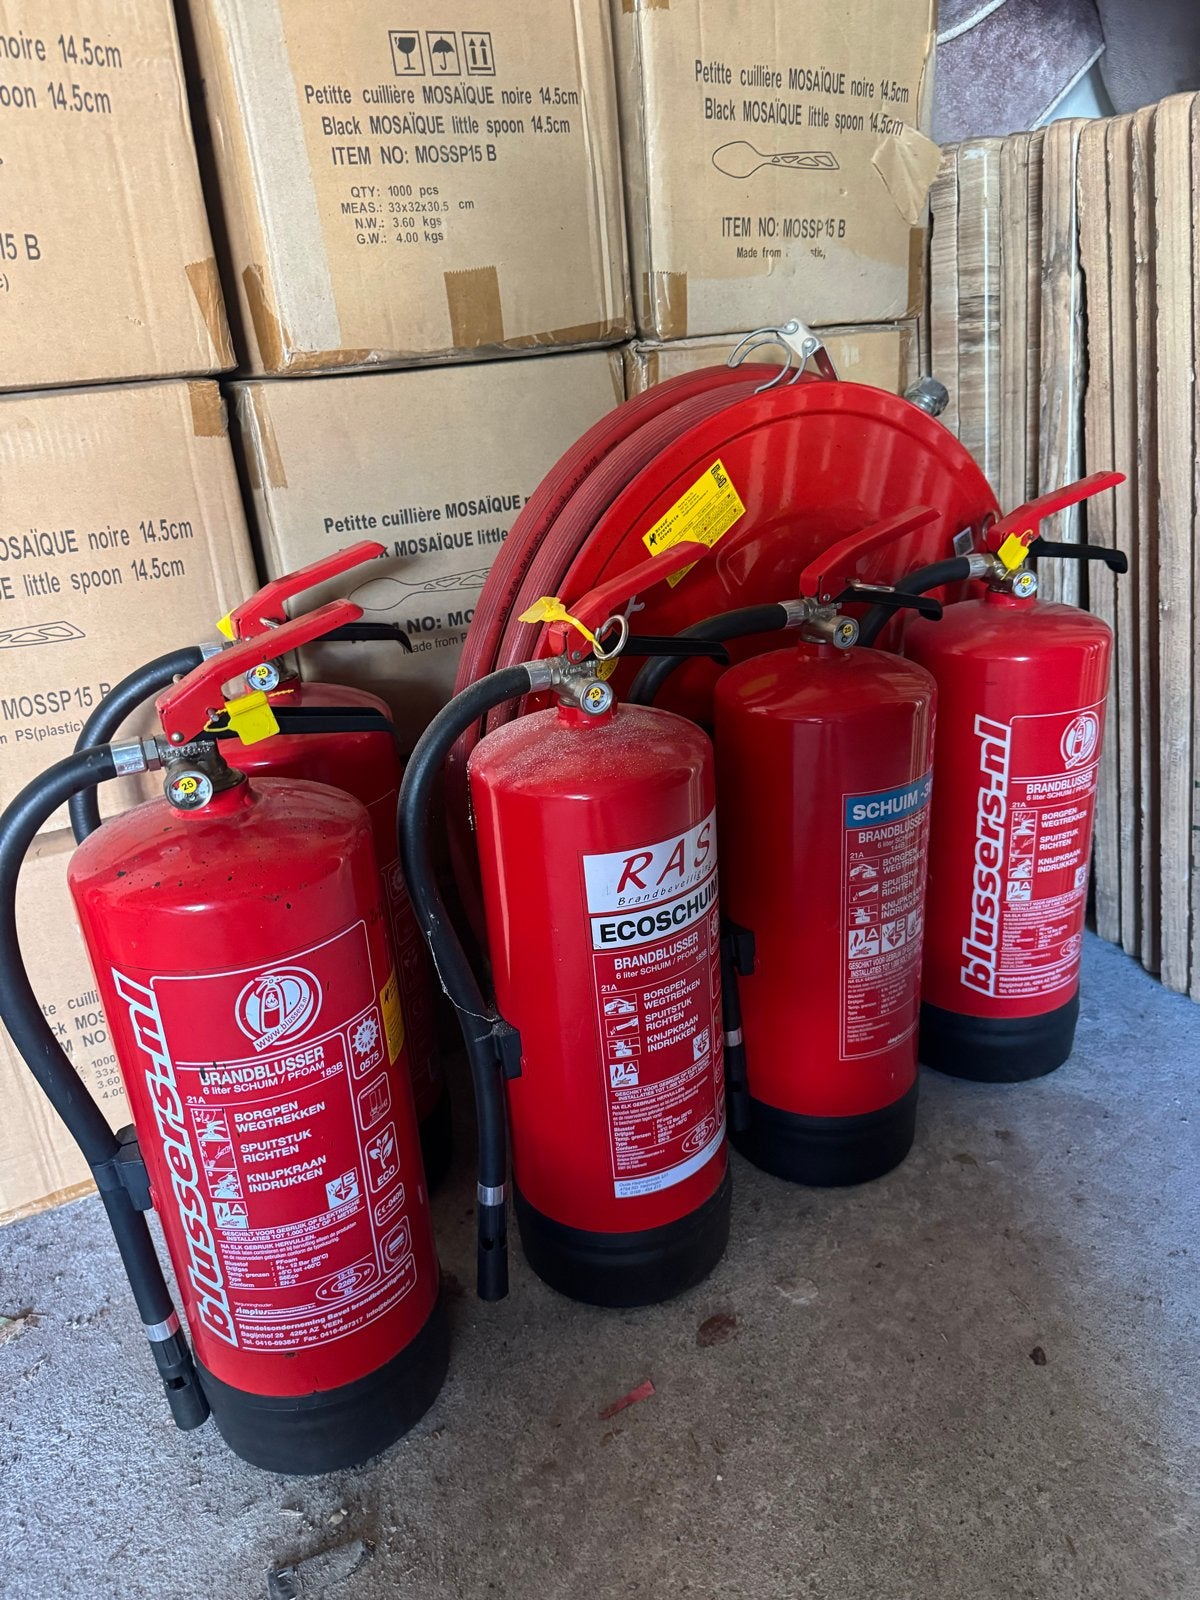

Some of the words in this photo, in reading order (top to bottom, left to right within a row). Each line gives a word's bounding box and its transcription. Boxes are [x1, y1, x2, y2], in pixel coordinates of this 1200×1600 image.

[58, 33, 122, 69] 14.5cm
[304, 84, 352, 105] Petitte
[362, 81, 415, 105] cuillière
[422, 81, 495, 106] MOSAÏQUE
[501, 84, 533, 105] noire
[538, 85, 580, 106] 14.5cm
[694, 59, 733, 87] Petitte
[739, 66, 783, 91] cuillière
[788, 66, 846, 97] MOSAÏQUE
[850, 78, 875, 98] noire
[880, 79, 910, 105] 14.5cm
[48, 81, 111, 114] 14.5cm
[321, 115, 362, 137] Black
[369, 111, 446, 136] MOSAÏQUE
[452, 114, 480, 136] little
[487, 118, 525, 138] spoon
[530, 114, 572, 135] 14.5cm
[704, 97, 737, 122] Black
[742, 98, 802, 128] MOSAÏQUE
[807, 106, 830, 131] little
[835, 112, 864, 135] spoon
[869, 114, 905, 138] 14.5cm
[331, 145, 371, 166] ITEM
[380, 145, 408, 166] NO:
[415, 144, 483, 166] MOSSP15
[486, 144, 497, 164] B
[350, 185, 381, 199] QTY:
[387, 184, 412, 198] 1000
[418, 184, 440, 199] pcs
[340, 202, 383, 215] MEAS.:
[388, 199, 450, 214] 33x32x30.5
[458, 199, 476, 211] cm
[354, 217, 386, 231] N.W.:
[392, 215, 416, 229] 3.60
[422, 213, 443, 230] kgs
[721, 216, 752, 239] ITEM
[758, 217, 780, 239] NO:
[838, 218, 847, 239] B
[25, 233, 41, 259] B
[356, 232, 388, 246] G.W.:
[396, 230, 420, 244] 4.00
[424, 227, 445, 244] kgs
[736, 246, 758, 259] Made
[761, 246, 782, 260] from
[323, 512, 378, 535] Petitte
[382, 507, 442, 531] cuillière
[445, 493, 522, 520] MOSAÏQUE
[88, 525, 131, 551] noire
[139, 518, 195, 544] 14.5cm
[394, 532, 474, 558] MOSAÏQUE
[477, 527, 509, 546] little
[23, 571, 62, 597] little
[72, 565, 123, 595] spoon
[131, 557, 186, 582] 14.5cm
[406, 615, 443, 635] NO:
[435, 634, 460, 650] from
[181, 781, 194, 791] 25
[1026, 770, 1093, 794] BRANDBLUSSER
[852, 789, 919, 822] SCHUIM
[1011, 801, 1027, 809] 21A
[849, 851, 865, 860] 21A
[960, 713, 1012, 998] blussers.nl
[1038, 838, 1072, 851] RICHTEN
[616, 822, 711, 894] RAS
[1037, 857, 1078, 873] INDRUKKEN
[1020, 881, 1031, 890] A
[866, 927, 880, 941] A
[613, 931, 700, 972] BRANDBLUSSER
[615, 972, 622, 981] 6
[623, 969, 638, 980] liter
[640, 959, 672, 977] SCHUIM
[676, 945, 700, 965] PFOAM
[600, 983, 618, 993] 21A
[642, 977, 687, 1002] BORGPEN
[643, 977, 702, 1011] WEGTREKKEN
[644, 996, 693, 1023] SPUITSTUK
[645, 1010, 685, 1032] RICHTEN
[256, 995, 308, 1049] www.blussers.nl
[646, 1014, 699, 1044] KNIJPKRAAN
[647, 1025, 696, 1054] INDRUKKEN
[91, 1054, 116, 1069] 1000
[199, 1045, 326, 1087] BRANDBLUSSER
[625, 1062, 638, 1074] A
[97, 1076, 121, 1089] 3.60
[203, 1085, 210, 1095] 6
[212, 1086, 232, 1096] liter
[233, 1078, 279, 1094] SCHUIM
[287, 1060, 326, 1082] PFOAM
[186, 1095, 206, 1105] 21A
[233, 1100, 299, 1123] BORGPEN
[235, 1101, 327, 1133] WEGTREKKEN
[240, 1128, 313, 1154] SPUITSTUK
[111, 966, 239, 1348] blussers.nl
[242, 1144, 300, 1164] RICHTEN
[246, 1154, 328, 1183] KNIJPKRAAN
[248, 1167, 324, 1193] INDRUKKEN
[341, 1171, 356, 1187] B
[376, 1163, 397, 1188] ECO
[231, 1203, 246, 1215] A
[255, 1229, 275, 1237] VOOR
[275, 1222, 307, 1235] GEBRUIK
[307, 1217, 318, 1227] OP
[271, 1231, 286, 1241] TOT
[304, 1222, 321, 1233] VOLT
[321, 1219, 331, 1228] OP
[337, 1205, 359, 1221] METER
[244, 1242, 274, 1252] GEBRUIK
[239, 1312, 327, 1331] Handelsonderneming
[327, 1307, 351, 1321] Bavel
[309, 1325, 320, 1336] AZ
[322, 1317, 344, 1331] VEEN
[303, 1332, 319, 1344] Fax.
